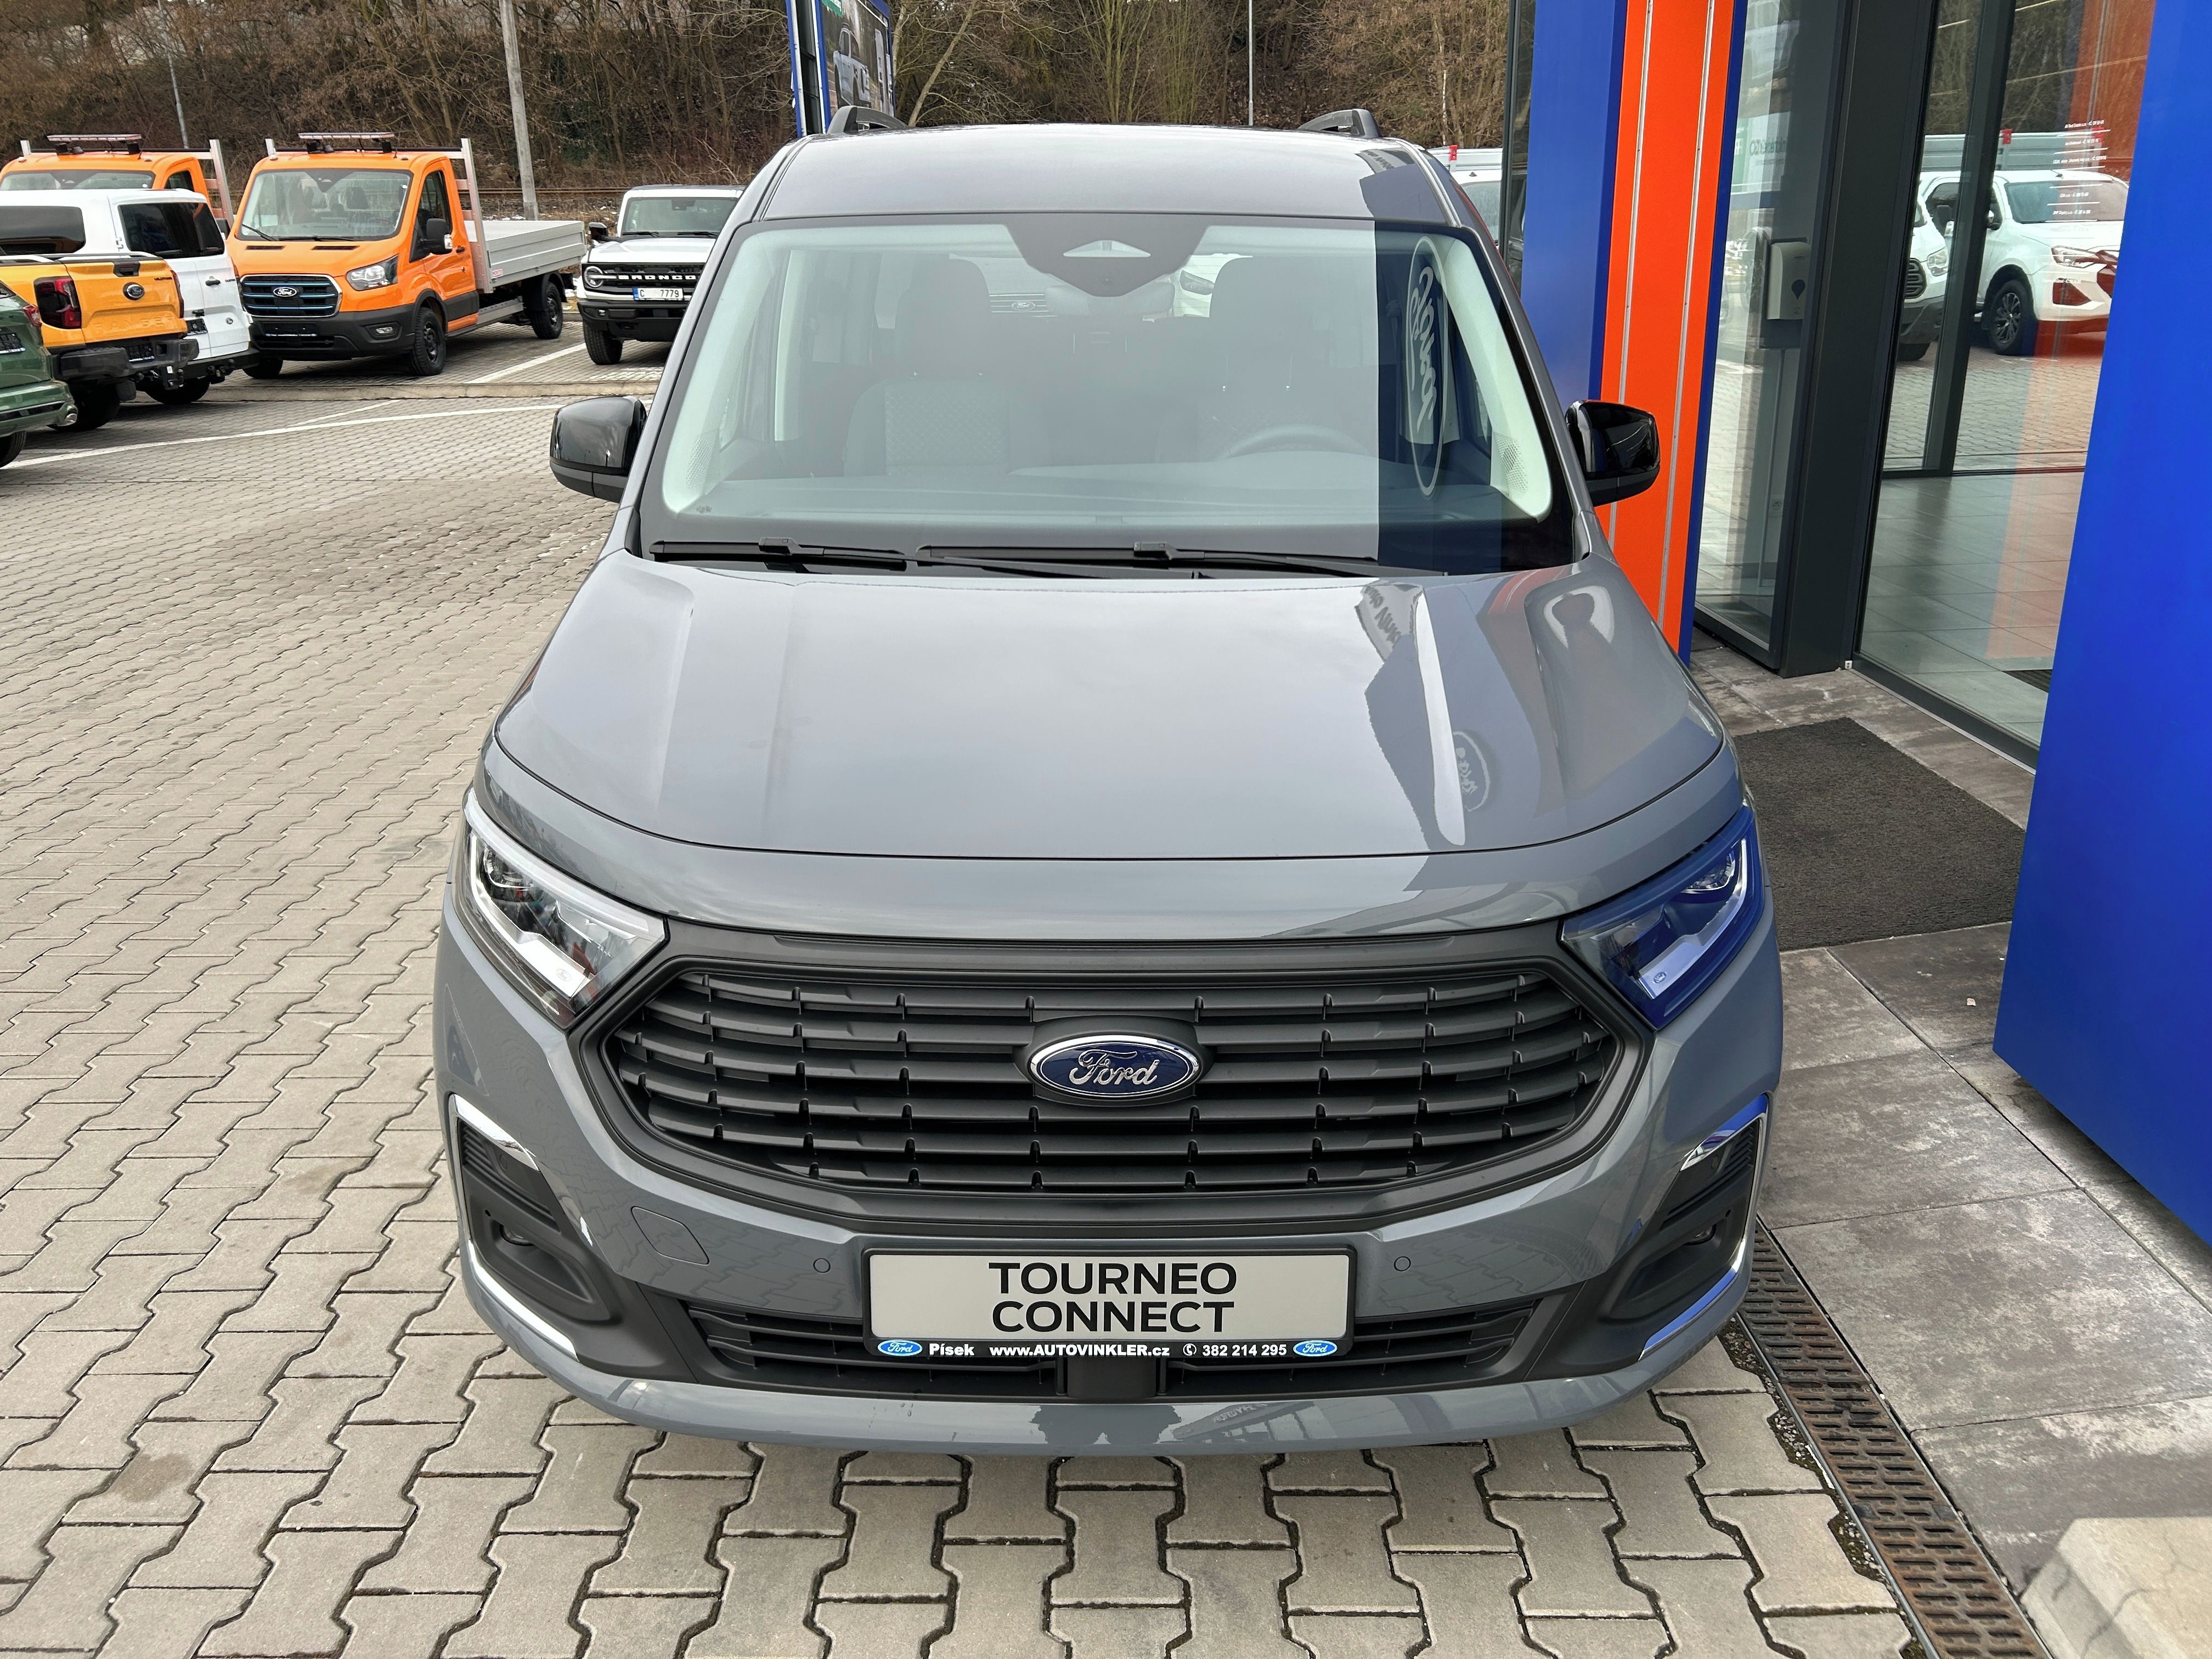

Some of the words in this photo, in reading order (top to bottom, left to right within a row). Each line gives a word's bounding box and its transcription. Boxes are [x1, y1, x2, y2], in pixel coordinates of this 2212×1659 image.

[660, 289, 679, 297] 7779
[1069, 1049, 1160, 1085] Ford
[989, 1262, 1237, 1295] TOURNEO
[992, 1301, 1234, 1333] CONNECT
[887, 1342, 913, 1353] Ford
[929, 1343, 975, 1356] Písek
[989, 1344, 1170, 1356] www.AUTOVINKLER.cz
[1202, 1344, 1228, 1356] 382
[1232, 1344, 1257, 1356] 214
[1261, 1344, 1287, 1356] 295
[1302, 1342, 1328, 1353] Ford
